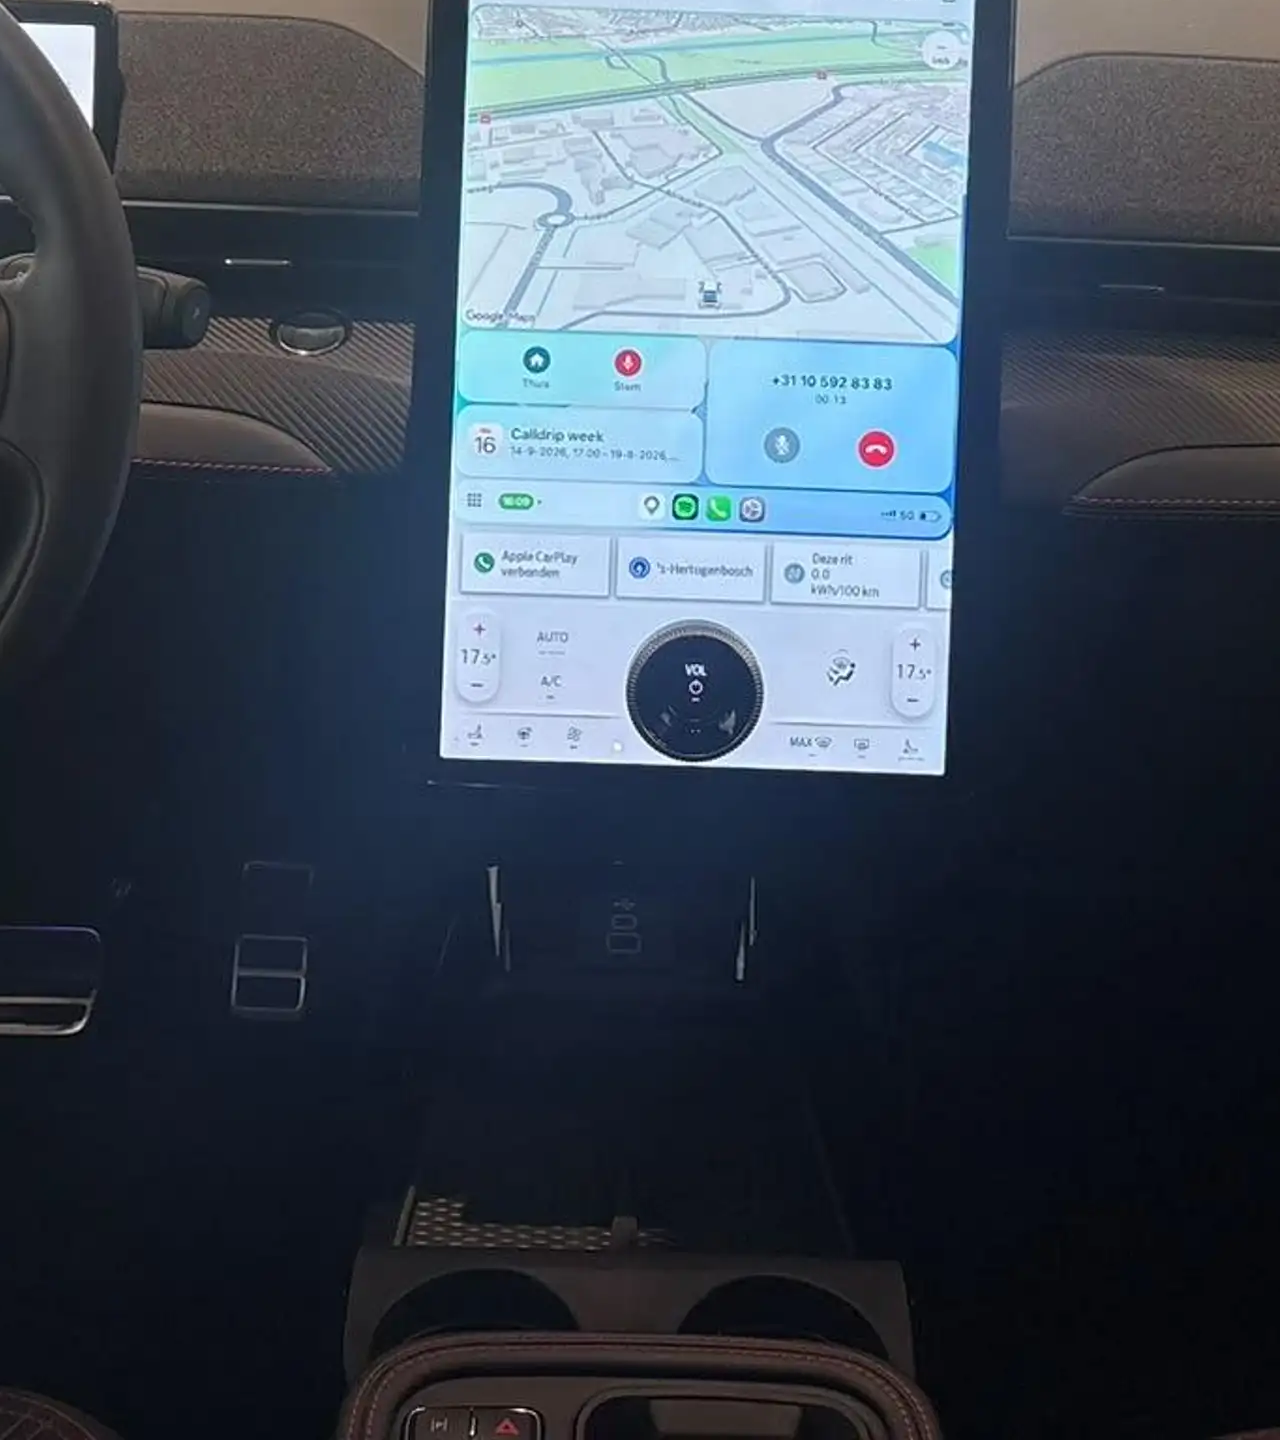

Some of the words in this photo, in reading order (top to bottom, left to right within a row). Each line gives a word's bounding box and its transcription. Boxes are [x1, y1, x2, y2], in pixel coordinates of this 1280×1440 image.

[465, 308, 504, 324] Google
[773, 374, 796, 386] +31
[801, 375, 817, 387] 10
[820, 375, 847, 388] 592
[567, 430, 604, 442] week
[474, 436, 497, 454] 16
[501, 550, 534, 563] Apple
[535, 551, 578, 567] CarPlay
[840, 553, 853, 566] rit
[862, 584, 880, 598] km
[536, 631, 569, 644] AUTO
[684, 664, 708, 677] VOL
[540, 674, 562, 688] A/C
[789, 736, 812, 748] MAX
